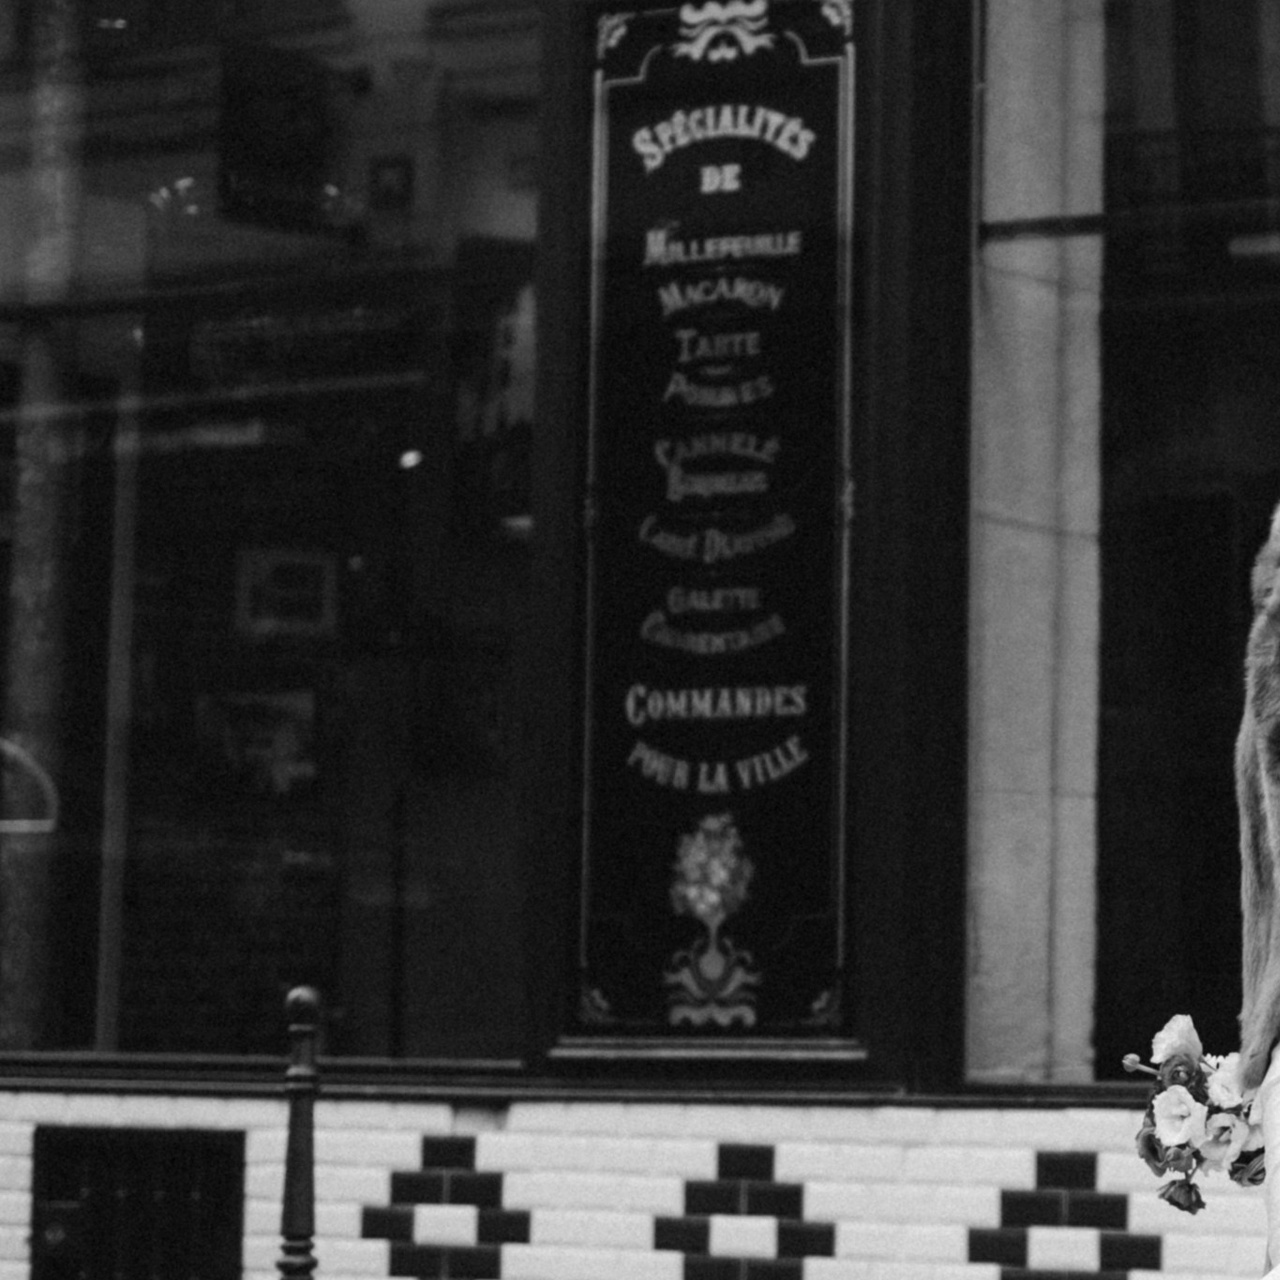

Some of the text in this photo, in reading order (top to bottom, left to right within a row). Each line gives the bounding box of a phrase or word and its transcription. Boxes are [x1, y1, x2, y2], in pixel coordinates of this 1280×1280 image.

[699, 163, 742, 195] DE
[657, 276, 785, 316] MACARON
[674, 327, 762, 364] TARTE
[624, 684, 809, 726] COMMANDES
[625, 734, 809, 793] POUR LA VILLE
